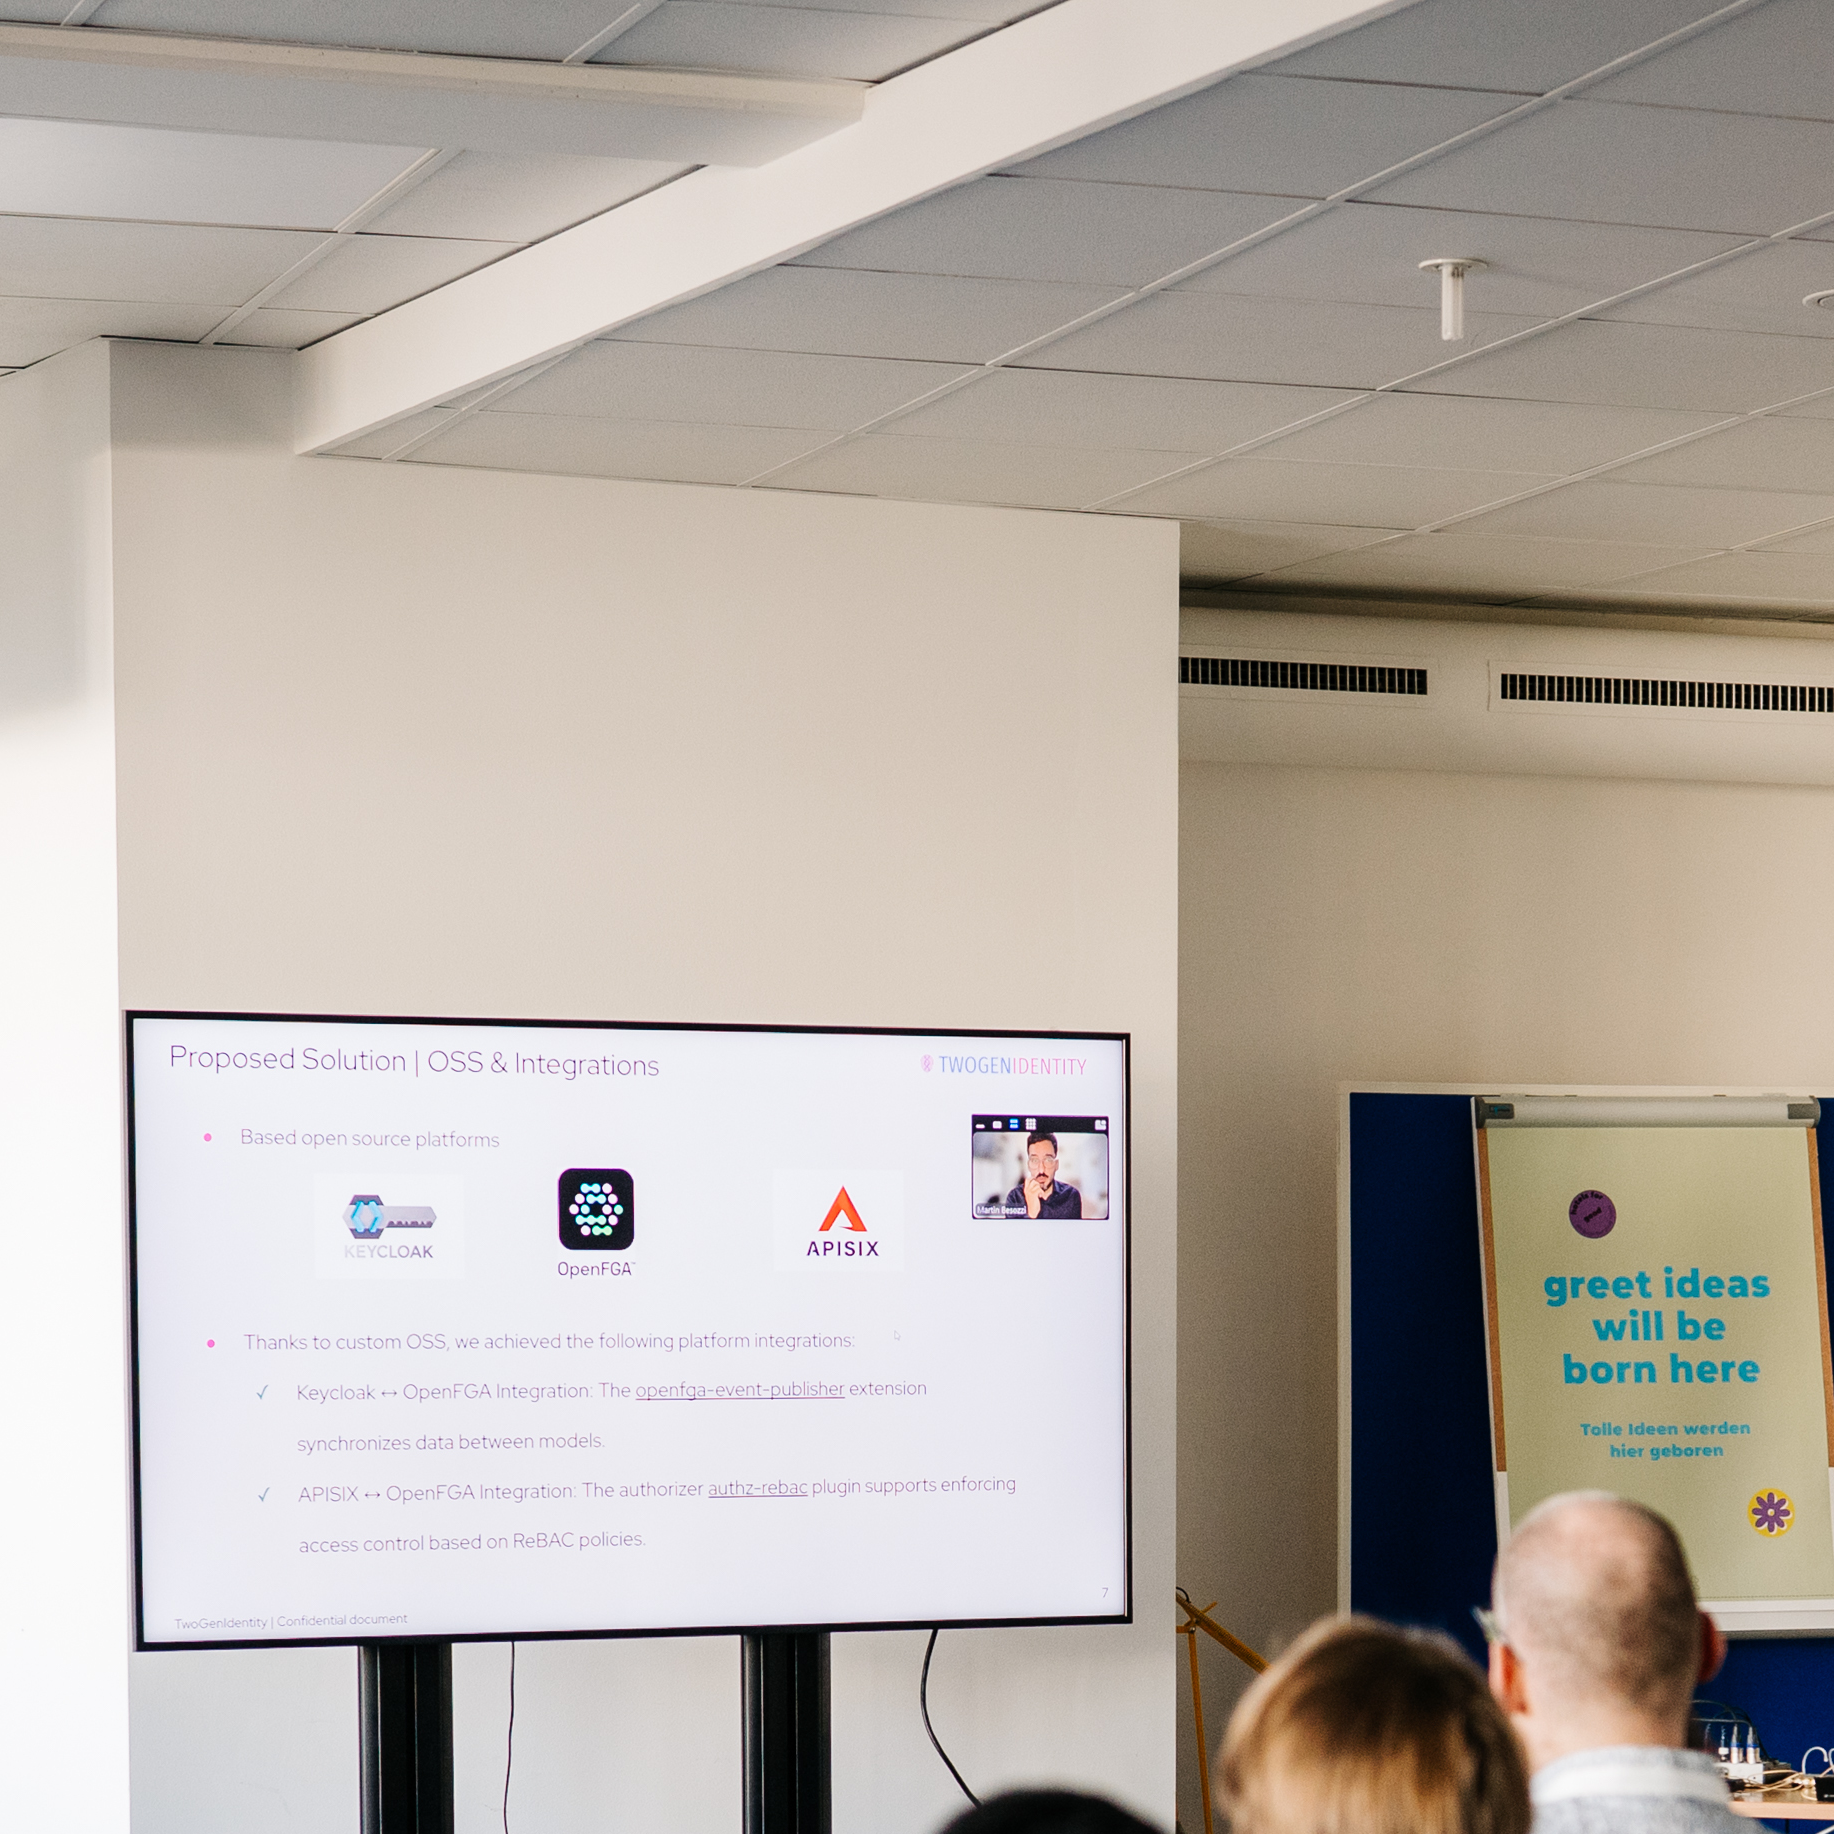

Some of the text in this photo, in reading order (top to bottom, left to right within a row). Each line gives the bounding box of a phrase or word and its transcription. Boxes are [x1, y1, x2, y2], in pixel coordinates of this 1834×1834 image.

[170, 1044, 295, 1075] Proposed
[302, 1047, 406, 1072] Solution
[427, 1049, 484, 1074] OSS
[490, 1051, 508, 1074] &
[515, 1051, 660, 1081] Integrations
[938, 1055, 1087, 1076] TWOGENIDENTITY
[240, 1127, 501, 1151] Based open source platforms
[1570, 1191, 1604, 1215] hotels for
[1584, 1207, 1602, 1223] good
[343, 1244, 434, 1259] KEYCLOAK
[806, 1240, 879, 1257] APISIX
[1544, 1266, 1771, 1307] greet ideas
[1593, 1309, 1726, 1342] will be
[243, 1331, 856, 1353] Thanks to custom OSS, we achieved the following platform integrations:
[1563, 1353, 1760, 1384] born here
[296, 1380, 928, 1405] Keycloak OpenFGA Integration: The openfga-event-publisher extension
[1580, 1421, 1751, 1437] Tolle Ideen werden
[297, 1432, 606, 1457] synchronizes data between models.
[1610, 1443, 1724, 1461] hier geboren
[297, 1475, 1017, 1505] APISIX OpenFGA Integration: The authorizer authz-rebac plugin supports enforcing
[298, 1531, 647, 1554] access control based on ReBAC policies.
[276, 1614, 347, 1628] Confidential
[348, 1614, 408, 1626] document
